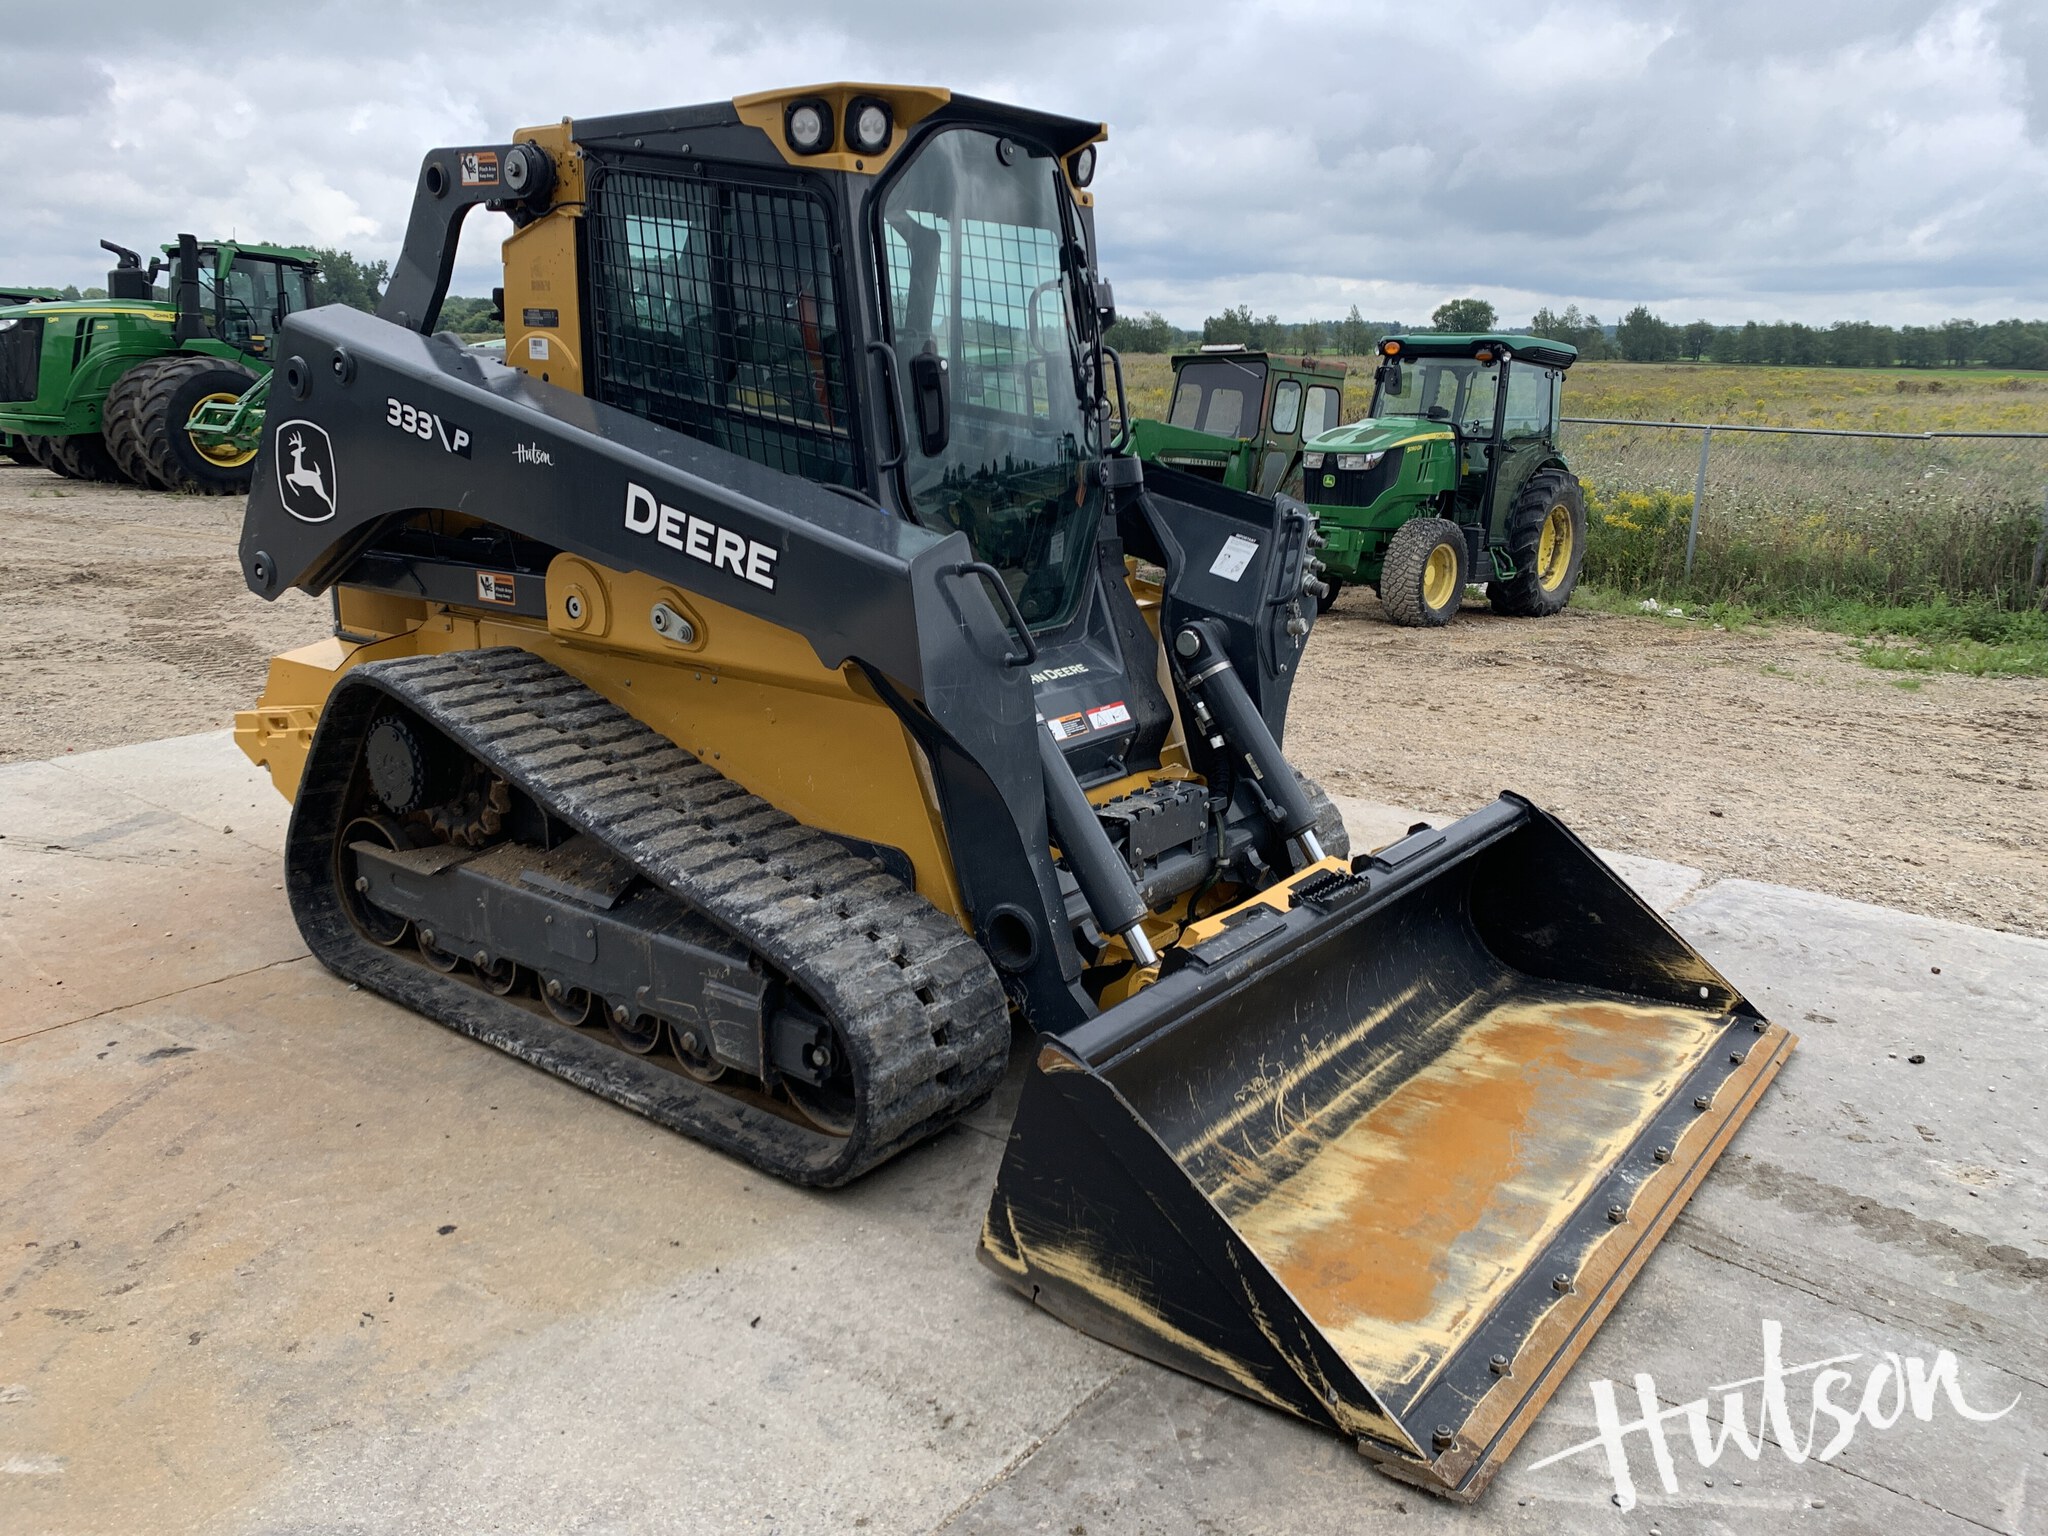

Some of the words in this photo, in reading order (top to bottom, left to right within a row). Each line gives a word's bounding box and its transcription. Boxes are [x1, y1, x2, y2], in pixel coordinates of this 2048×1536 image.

[512, 441, 554, 466] Hutson
[625, 482, 778, 590] DEERE
[1043, 663, 1089, 680] DEERE
